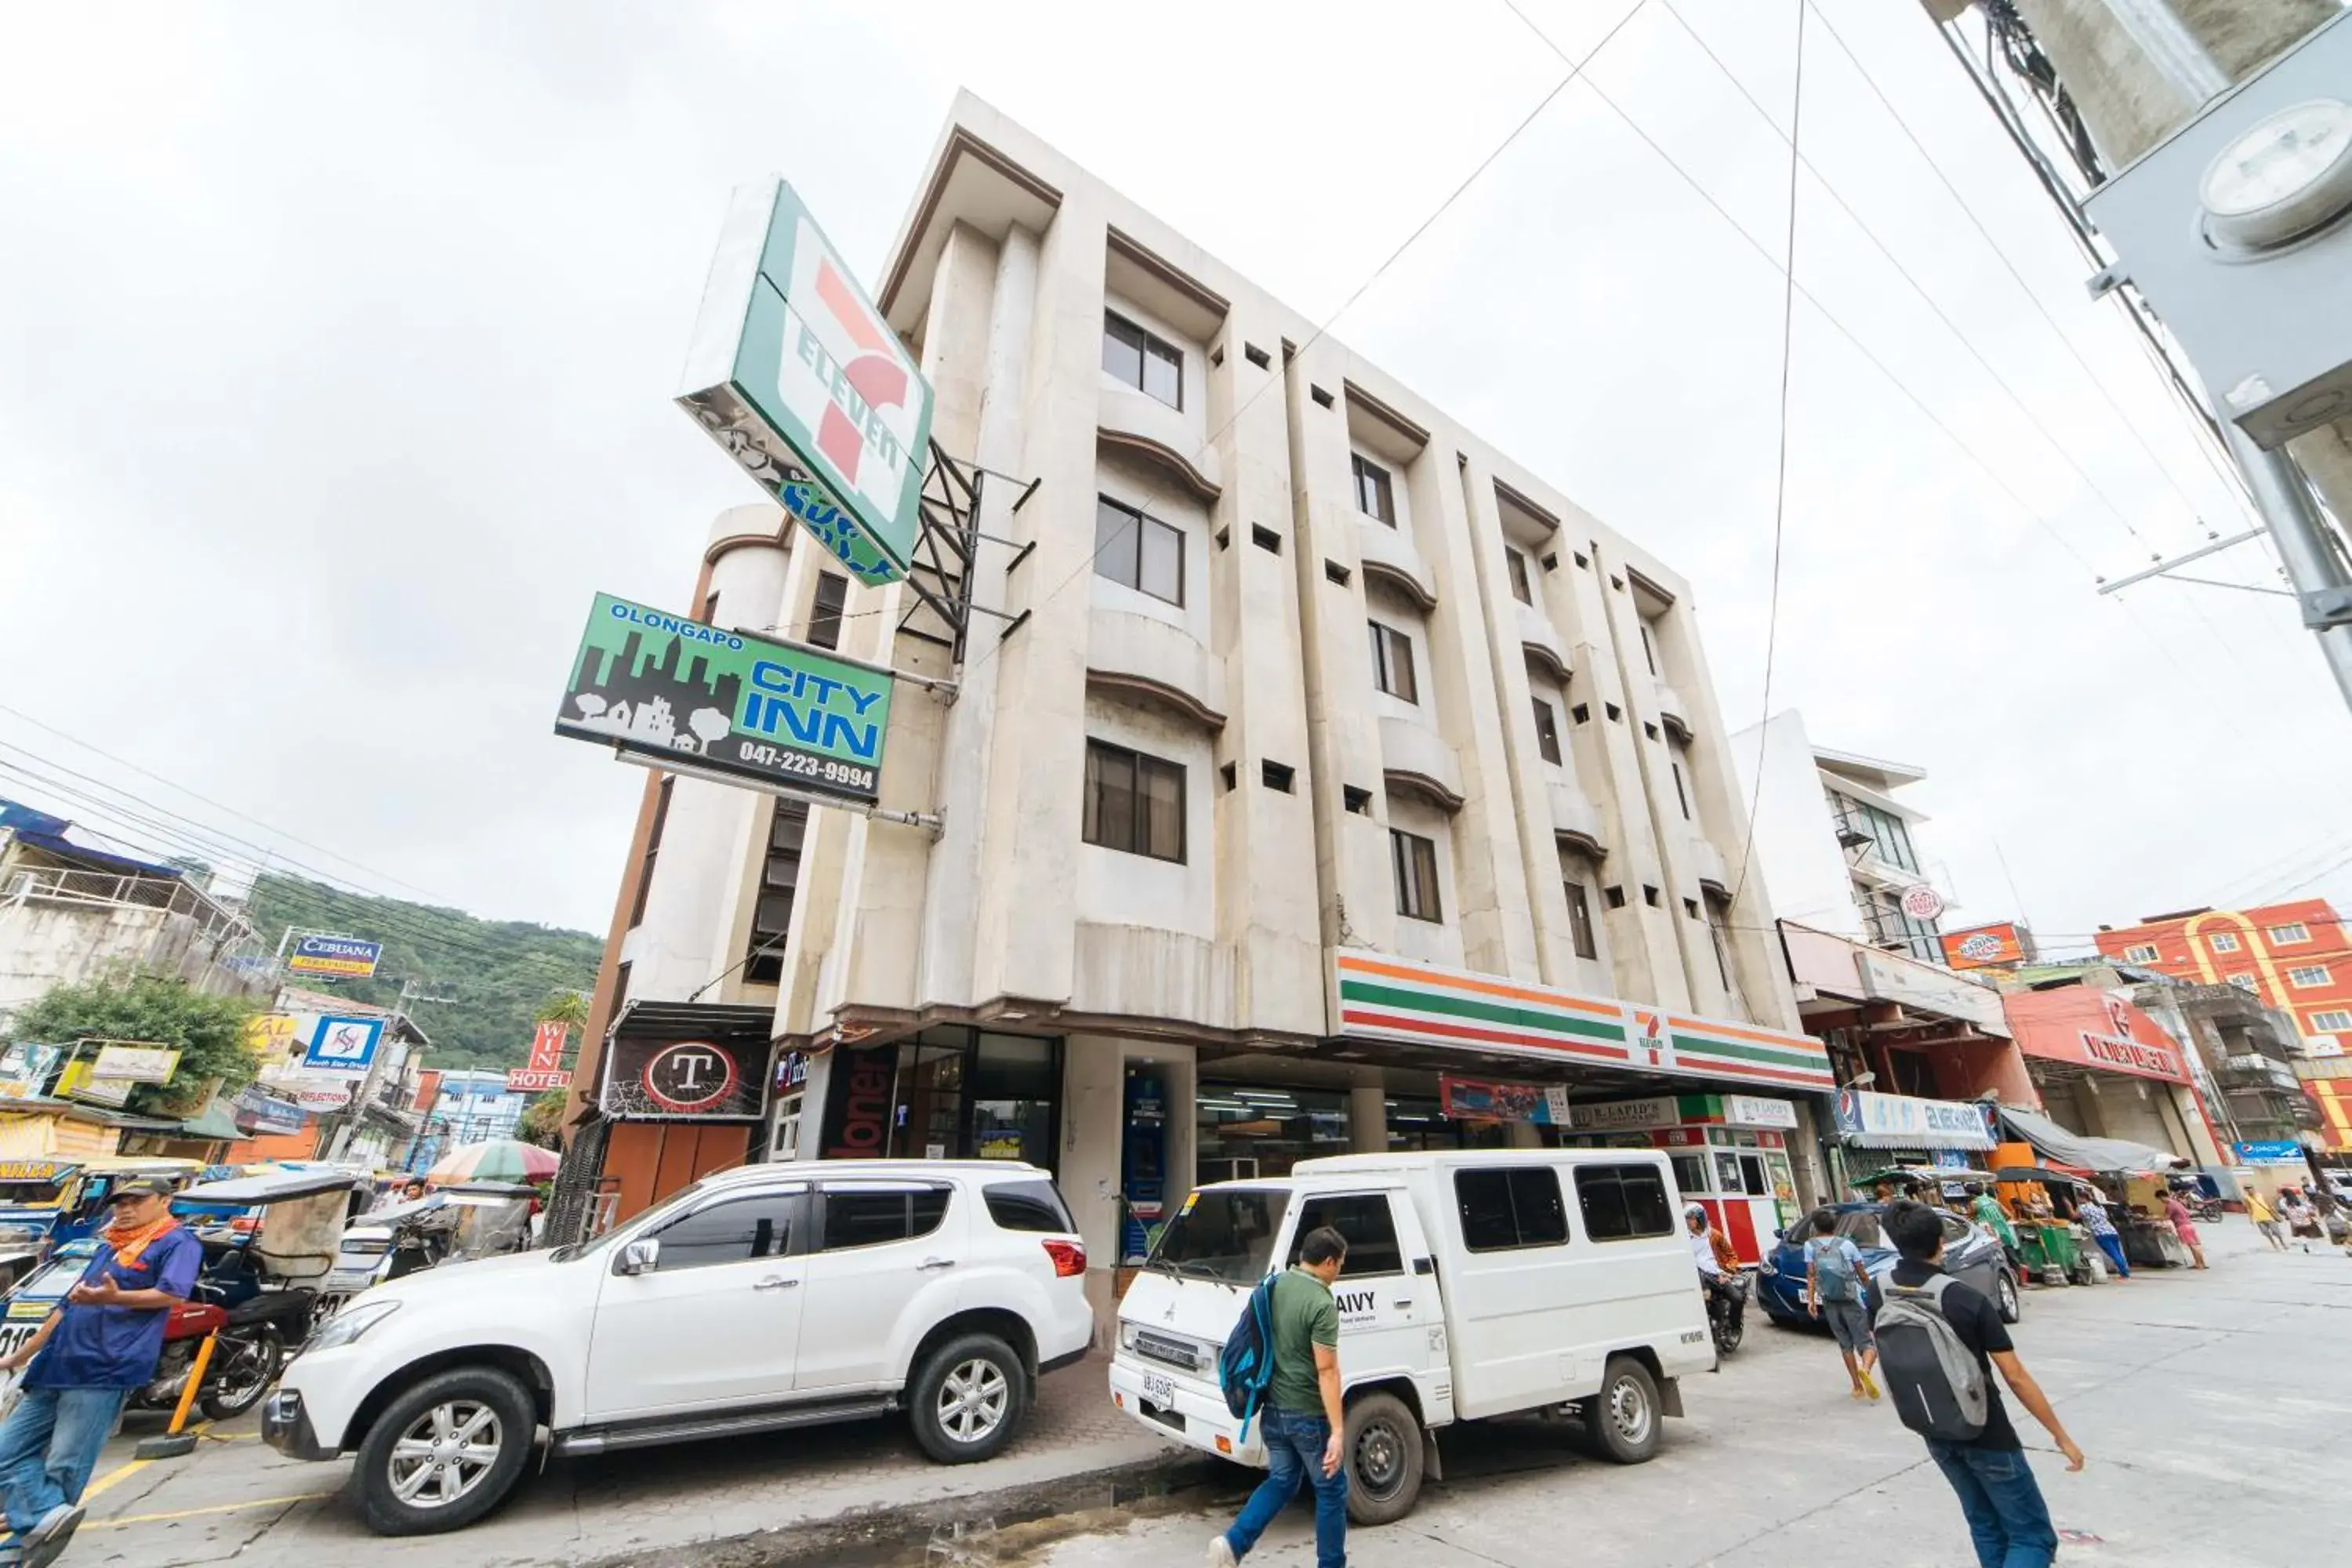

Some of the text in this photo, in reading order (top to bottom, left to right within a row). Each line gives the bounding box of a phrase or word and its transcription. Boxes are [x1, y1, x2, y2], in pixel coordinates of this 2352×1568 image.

[610, 603, 745, 652] OLONGAPO
[750, 659, 883, 717] CITY
[742, 691, 880, 759] INN
[739, 740, 874, 789] 047-223-9994
[302, 938, 373, 957] CEBUANA
[535, 1022, 564, 1067] WIN
[510, 1073, 569, 1087] HOTEL
[671, 1054, 713, 1089] T
